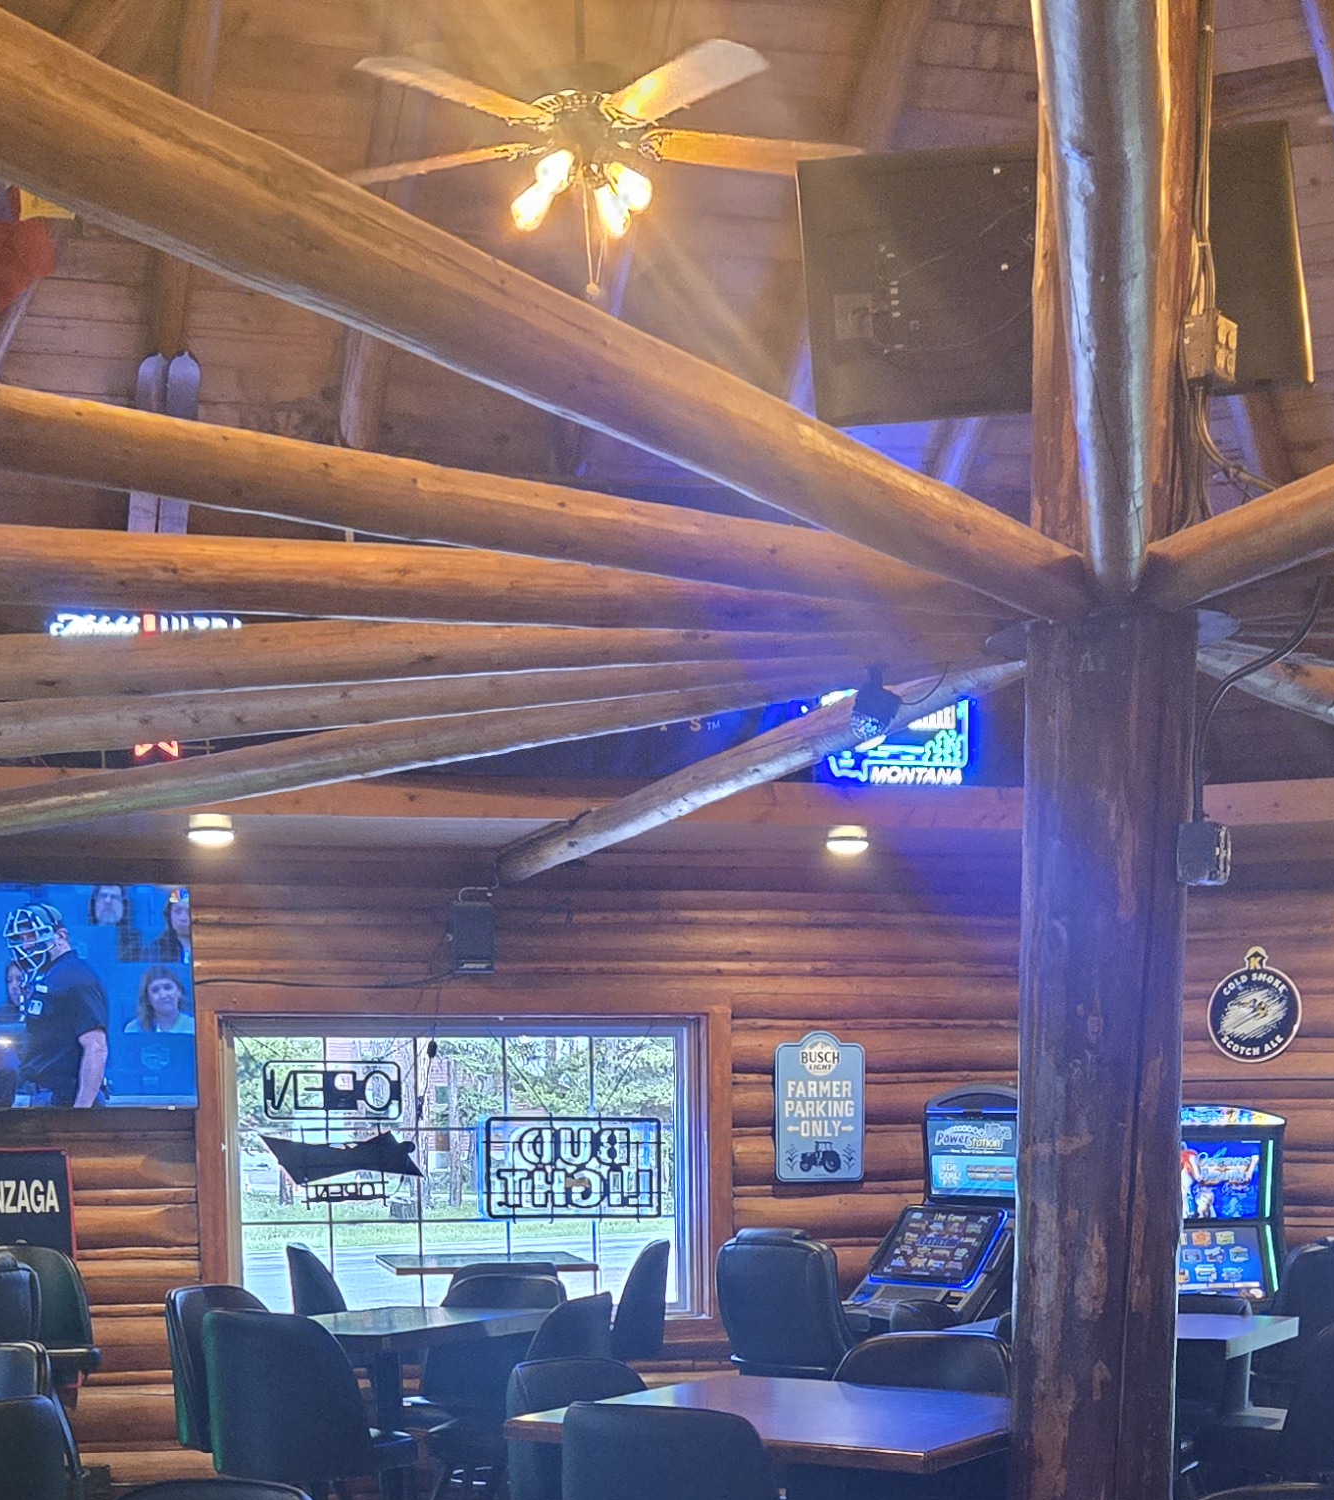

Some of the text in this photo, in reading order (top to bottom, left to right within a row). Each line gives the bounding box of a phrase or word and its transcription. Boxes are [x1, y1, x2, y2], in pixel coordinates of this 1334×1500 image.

[869, 766, 963, 785] MONTANA
[1222, 973, 1287, 995] COLD SMOKE
[1220, 1034, 1284, 1055] SCOTCH ALE
[801, 1051, 840, 1064] BUSCH
[786, 1081, 853, 1098] FARMER
[784, 1100, 855, 1118] PARKING
[799, 1120, 842, 1137] ONLY
